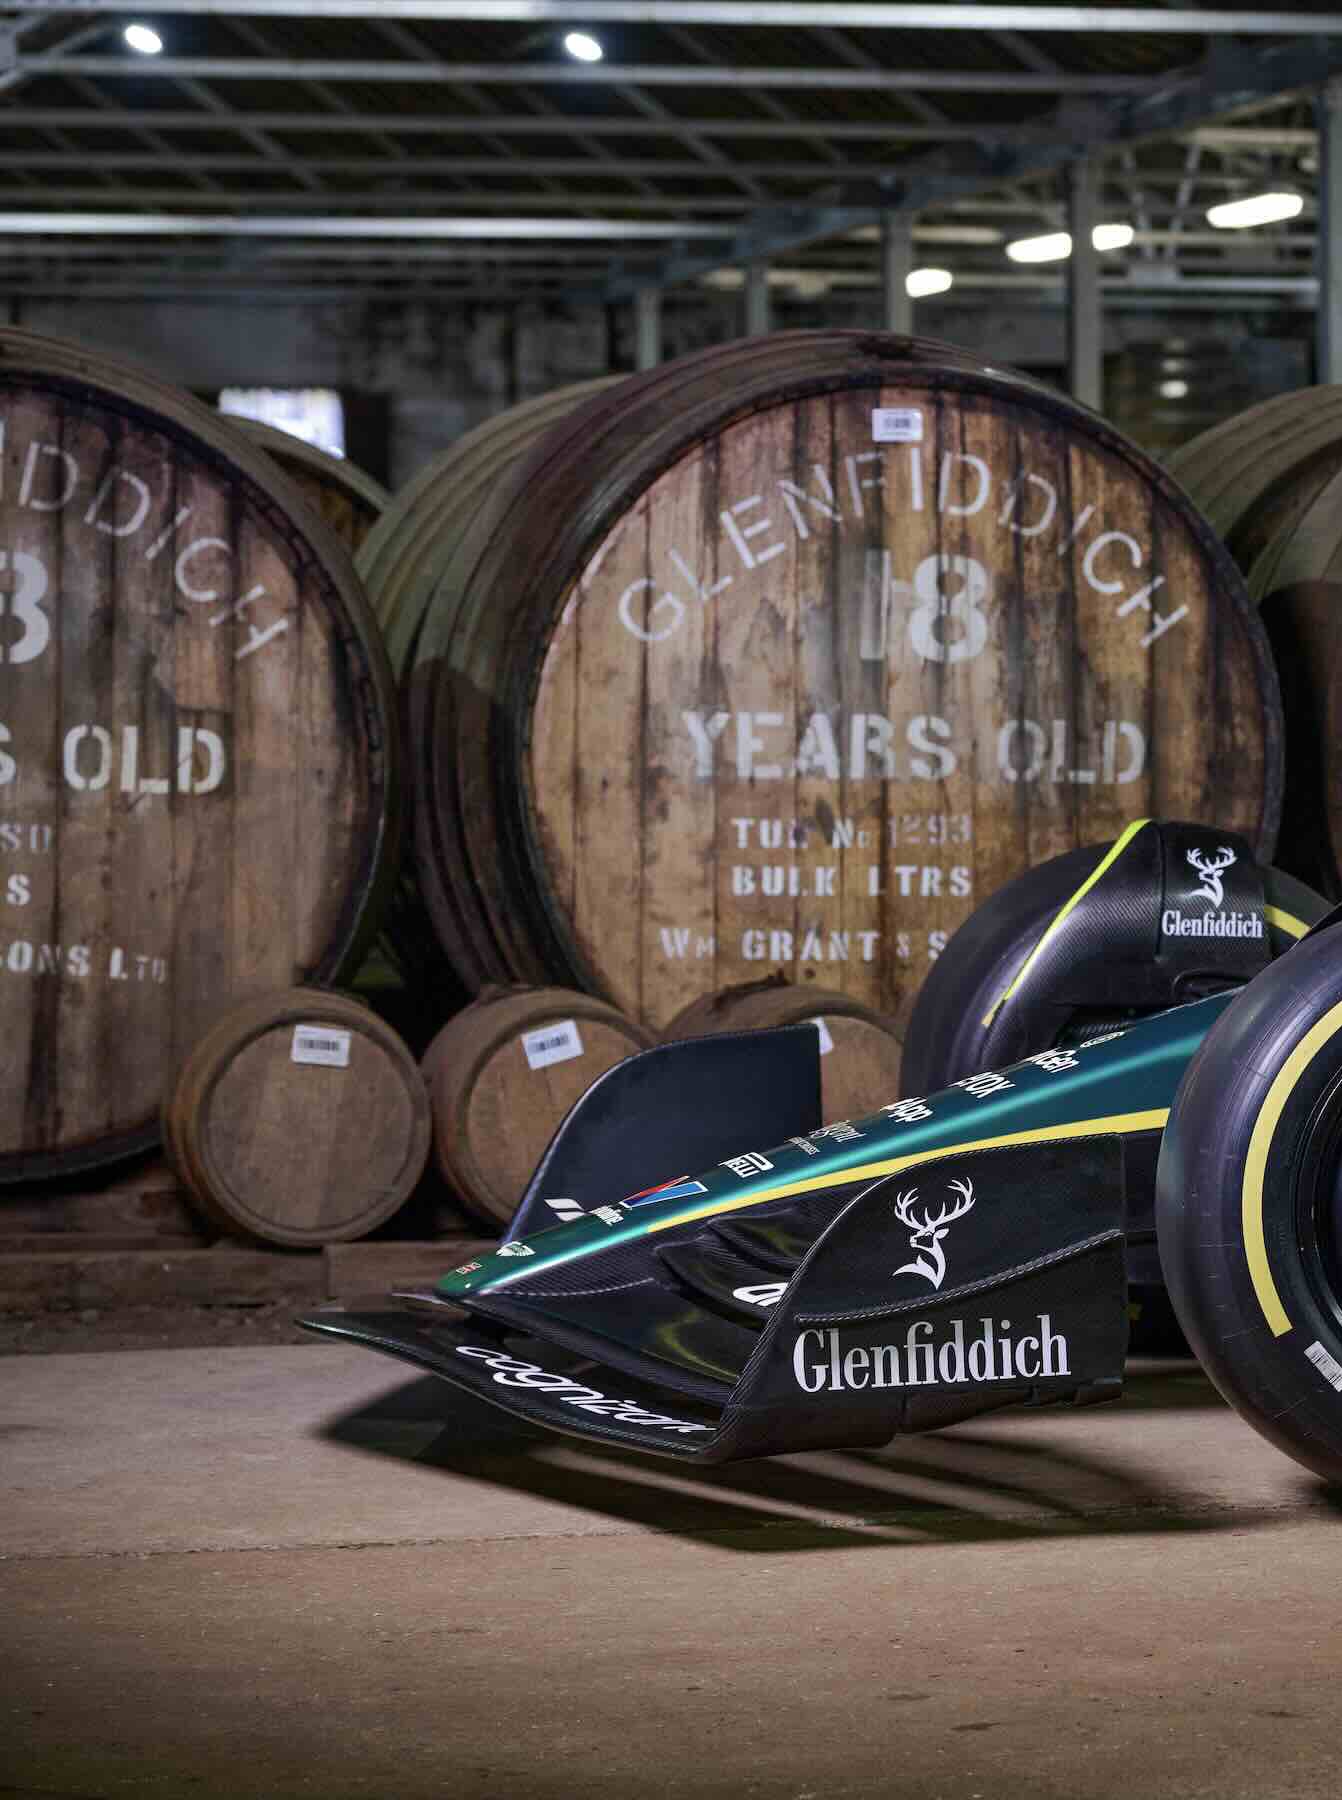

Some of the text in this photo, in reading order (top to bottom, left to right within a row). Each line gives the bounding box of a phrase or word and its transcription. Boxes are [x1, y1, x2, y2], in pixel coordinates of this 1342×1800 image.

[617, 447, 1189, 648] GLENFIDDICH
[860, 549, 989, 663] 18
[63, 724, 225, 794] OLD
[682, 711, 1147, 786] YEARS OLD
[732, 864, 836, 897] BULK
[0, 939, 90, 978] ONS
[742, 928, 881, 961] GRANT
[1161, 909, 1264, 938] Glenfiddich
[792, 1314, 1072, 1394] Glenfiddich
